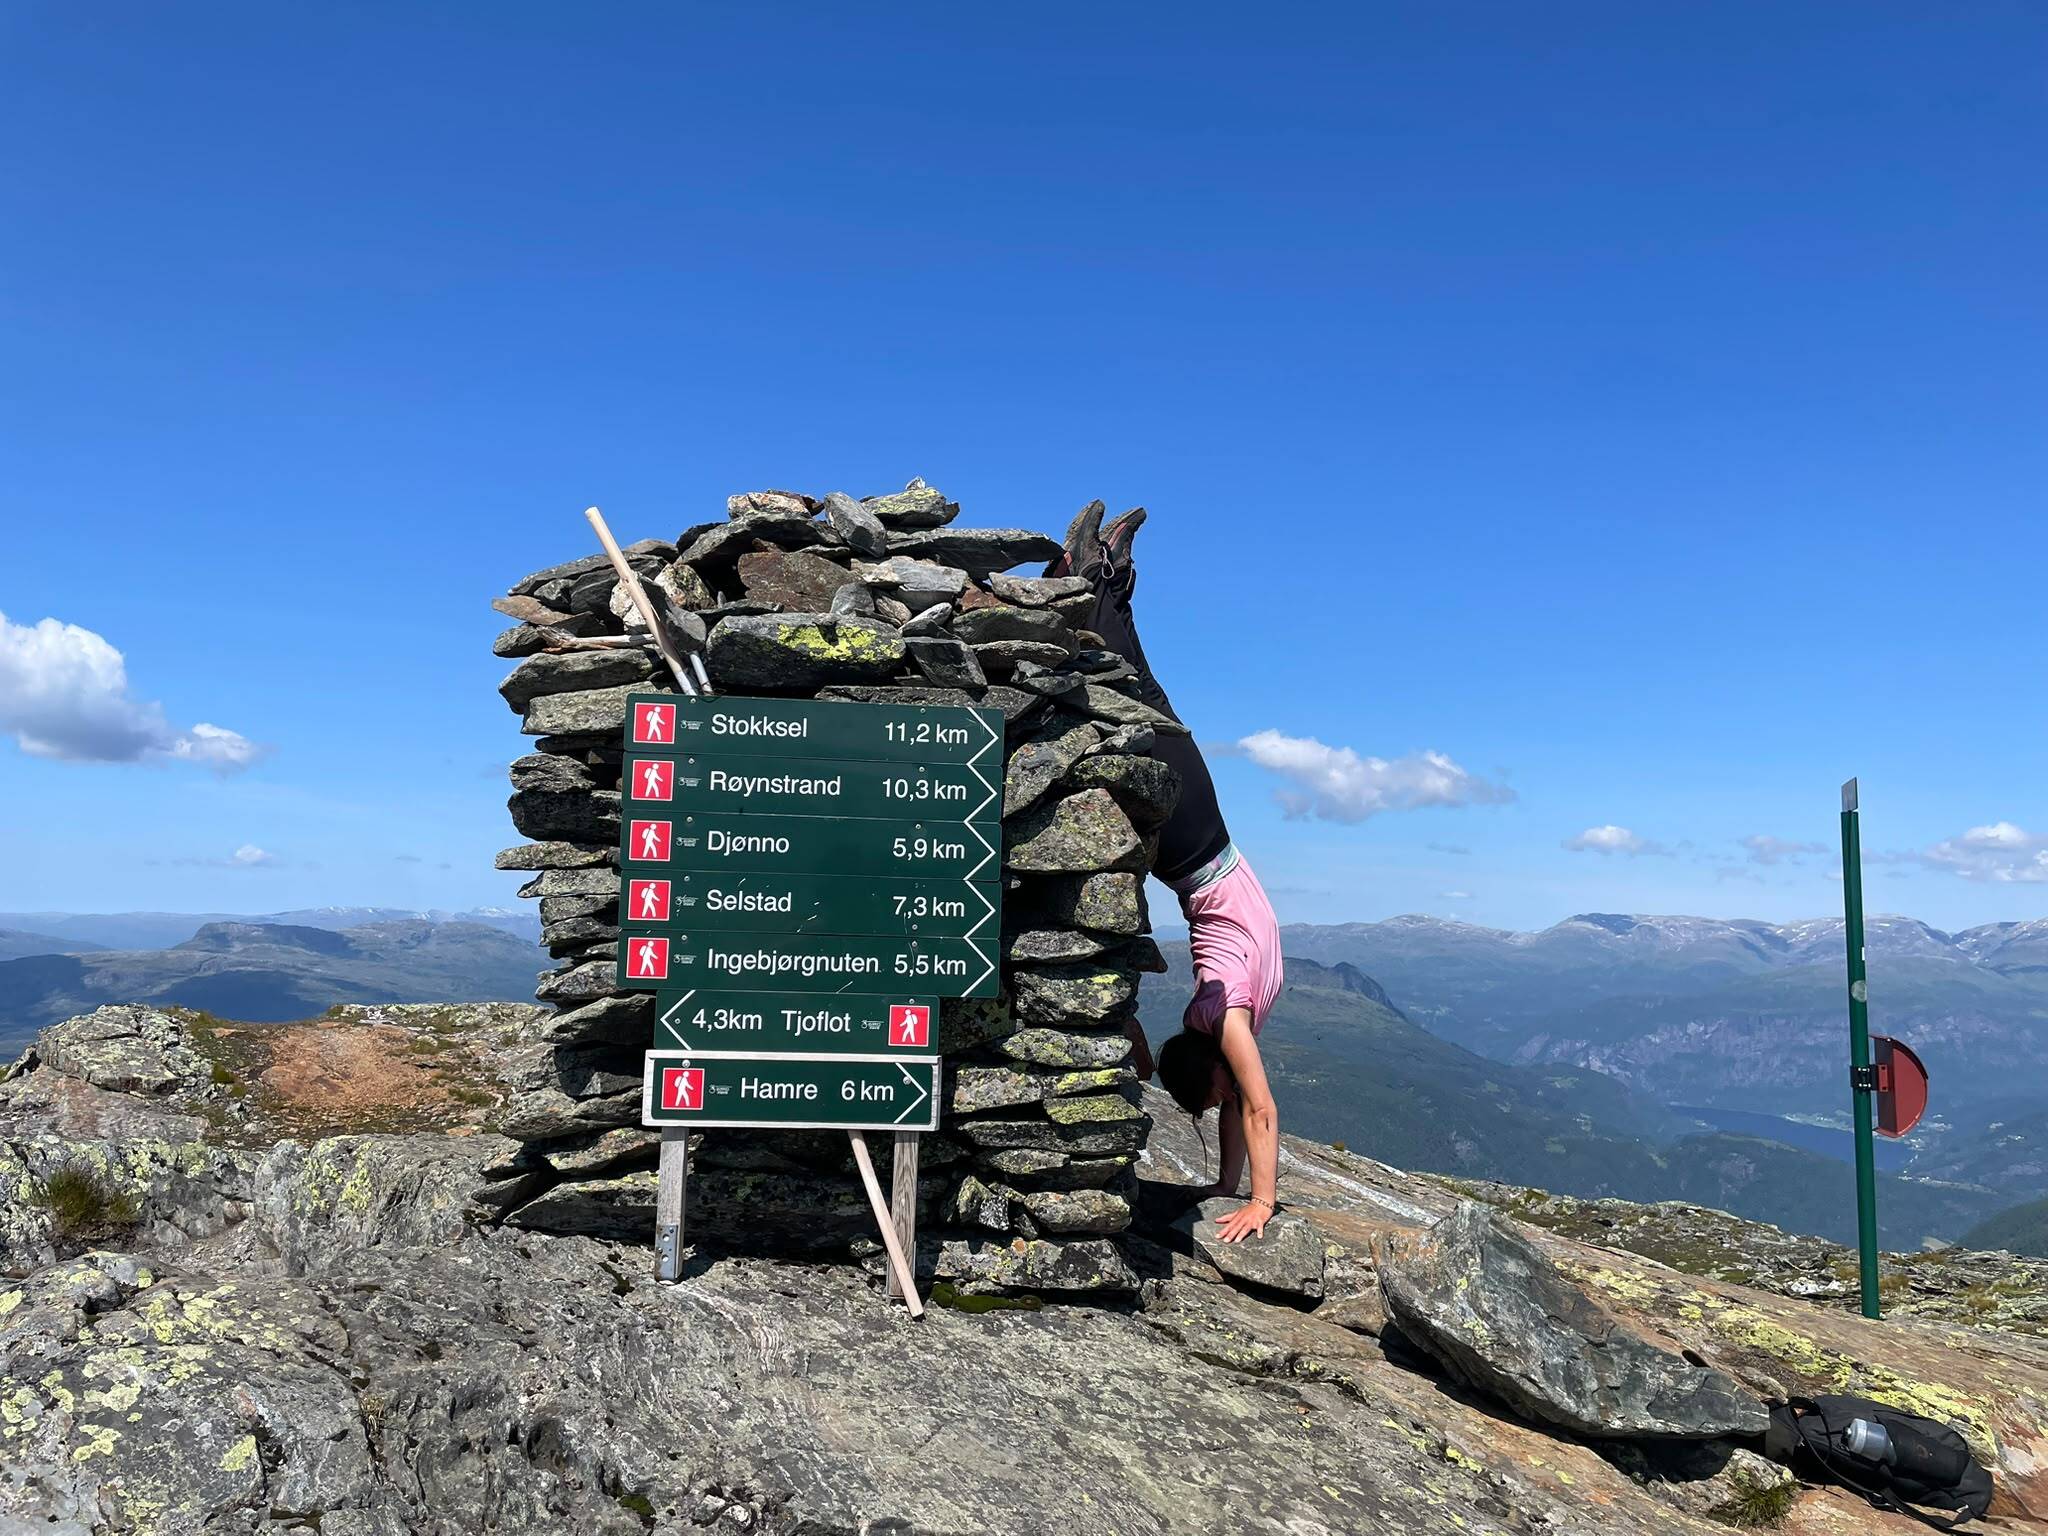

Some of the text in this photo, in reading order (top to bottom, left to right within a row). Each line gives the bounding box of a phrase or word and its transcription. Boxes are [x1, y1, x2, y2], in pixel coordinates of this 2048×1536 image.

[711, 713, 808, 738] Stokksel
[884, 721, 930, 746] 11,2
[935, 723, 968, 745] km
[710, 770, 841, 798] Røynstrand
[882, 778, 929, 802] 10,3
[934, 779, 967, 800] km
[707, 830, 790, 857] Djønno
[892, 837, 928, 861] 5,9
[932, 838, 965, 859] km
[706, 889, 792, 913] Selstad
[892, 895, 928, 919] 7,3
[932, 896, 965, 918] km
[708, 948, 879, 977] Ingebjørgnuten
[894, 954, 929, 977] 5,5
[933, 954, 967, 976] km
[780, 1009, 851, 1037] Tjoflot
[740, 1077, 818, 1100] Hamre
[841, 1080, 856, 1101] 6
[860, 1079, 894, 1101] km
